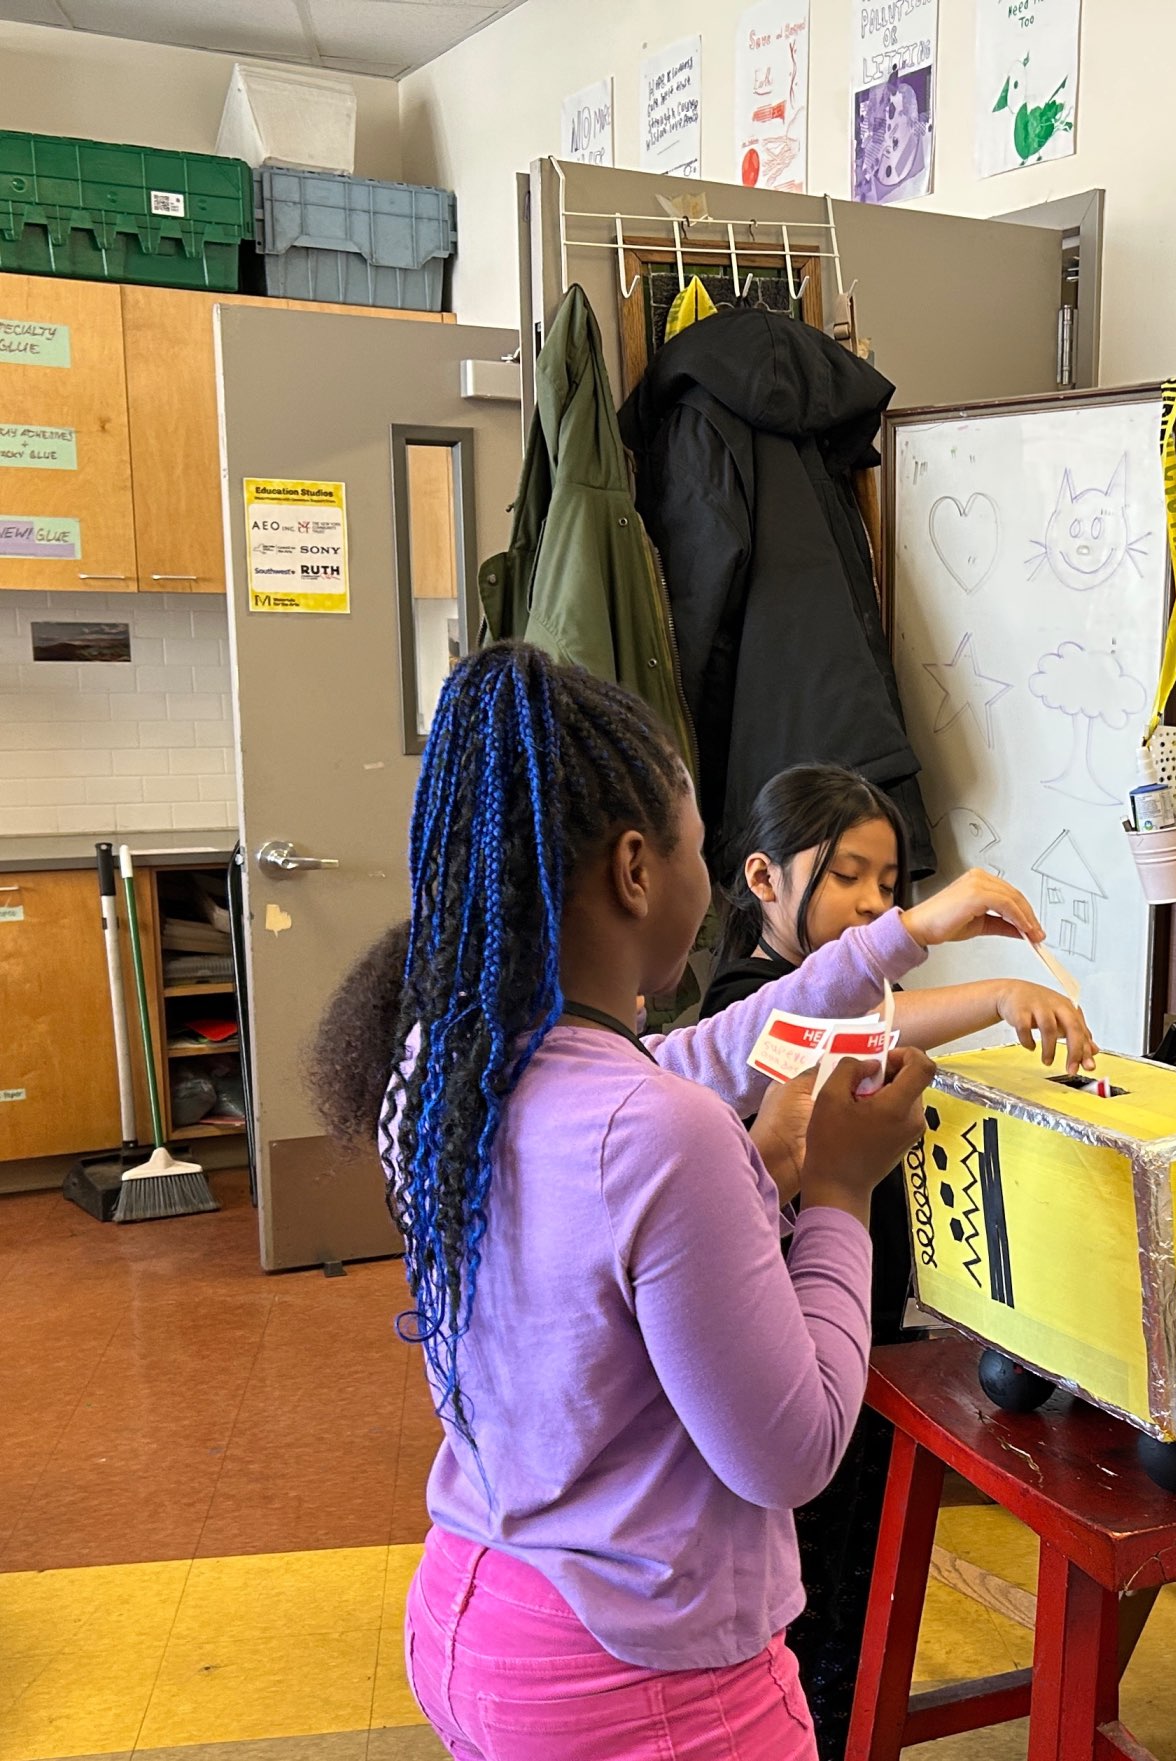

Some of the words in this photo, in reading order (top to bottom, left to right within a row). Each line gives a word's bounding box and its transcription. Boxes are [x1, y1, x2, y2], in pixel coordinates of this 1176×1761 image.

[1018, 15, 1034, 28] Too
[255, 486, 299, 496] Education
[300, 488, 334, 498] Studios
[251, 521, 280, 531] AEO
[36, 528, 71, 543] GLUE
[300, 546, 340, 555] SONY
[300, 565, 340, 575] RUTH
